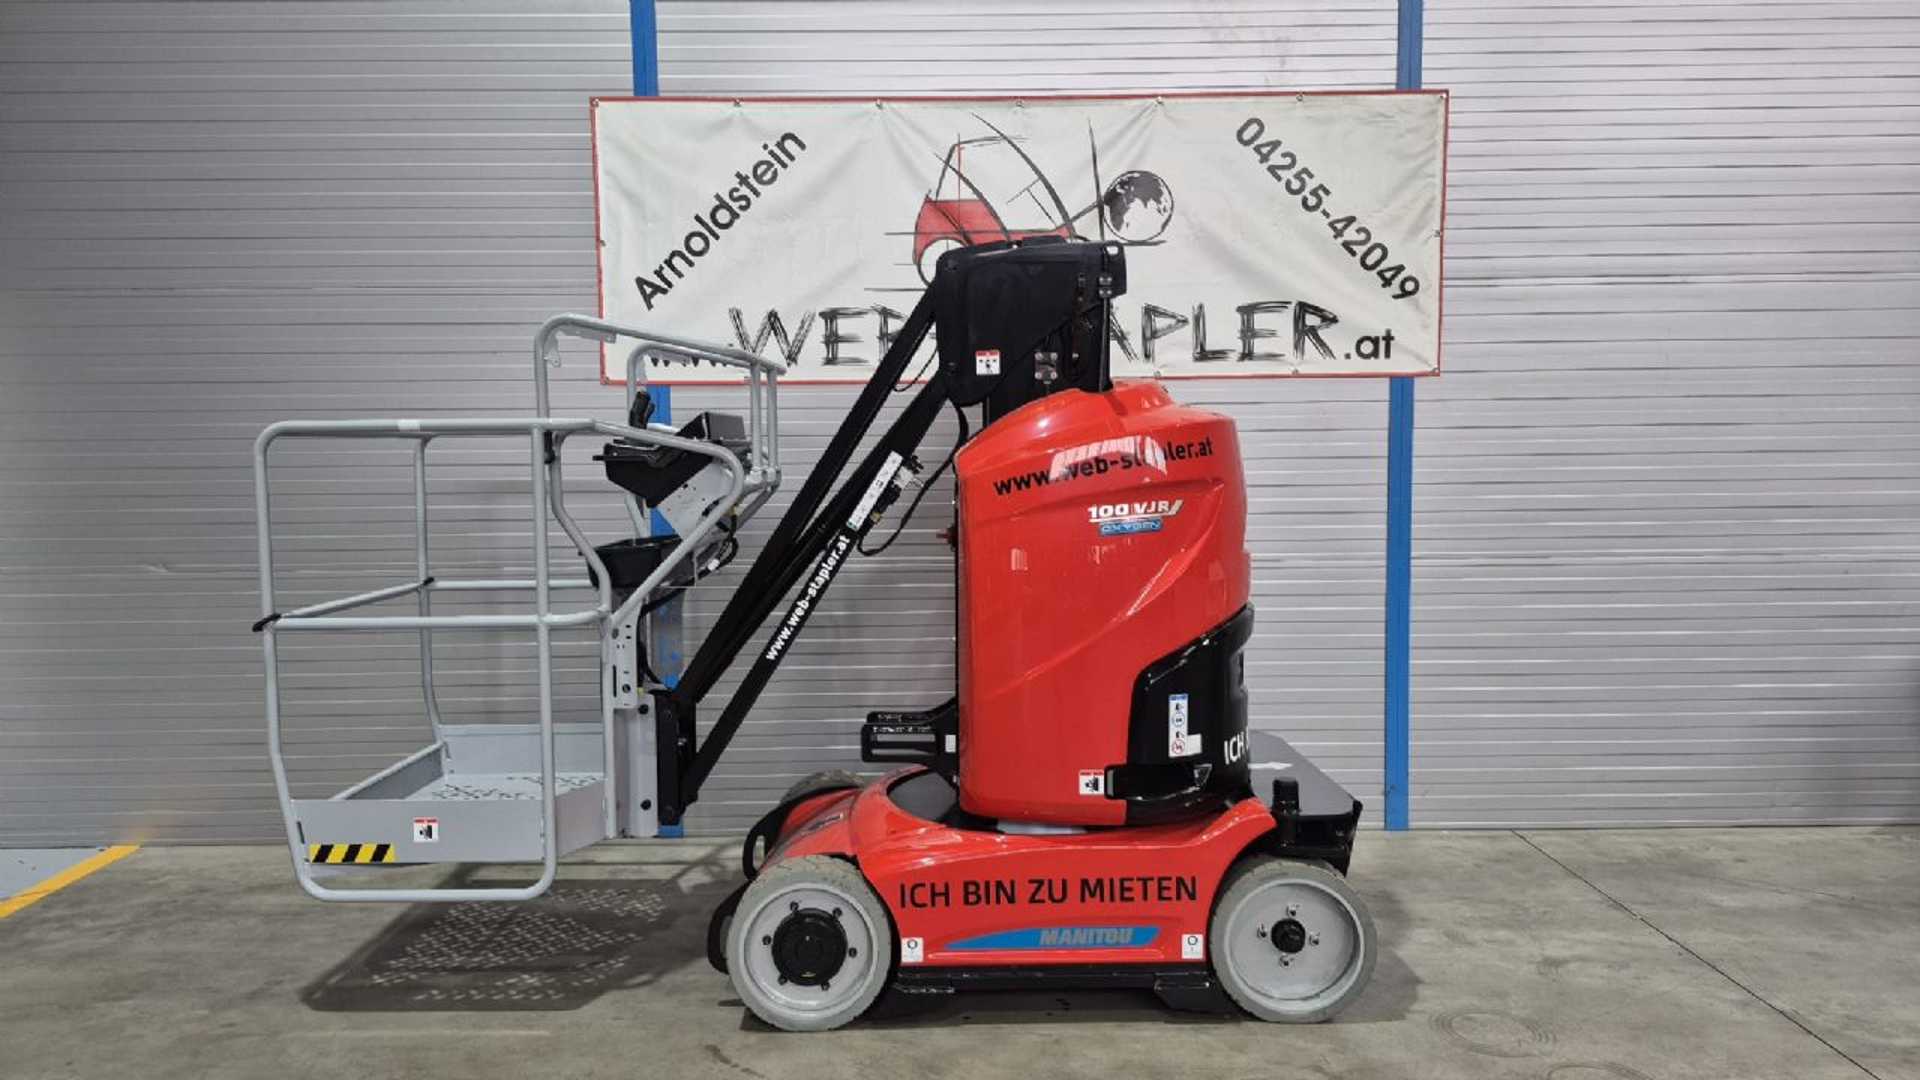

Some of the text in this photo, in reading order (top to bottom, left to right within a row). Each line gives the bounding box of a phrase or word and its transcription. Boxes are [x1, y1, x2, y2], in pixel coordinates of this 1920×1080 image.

[635, 131, 807, 310] Arnoldstein
[1235, 117, 1421, 300] 04255-42049
[1087, 501, 1169, 518] 100 VJR
[766, 534, 850, 661] www.web-stapler.at
[1223, 731, 1245, 765] ICH
[900, 876, 1197, 908] ICH BIN ZU MIETEN
[1039, 927, 1134, 945] MANITOU
